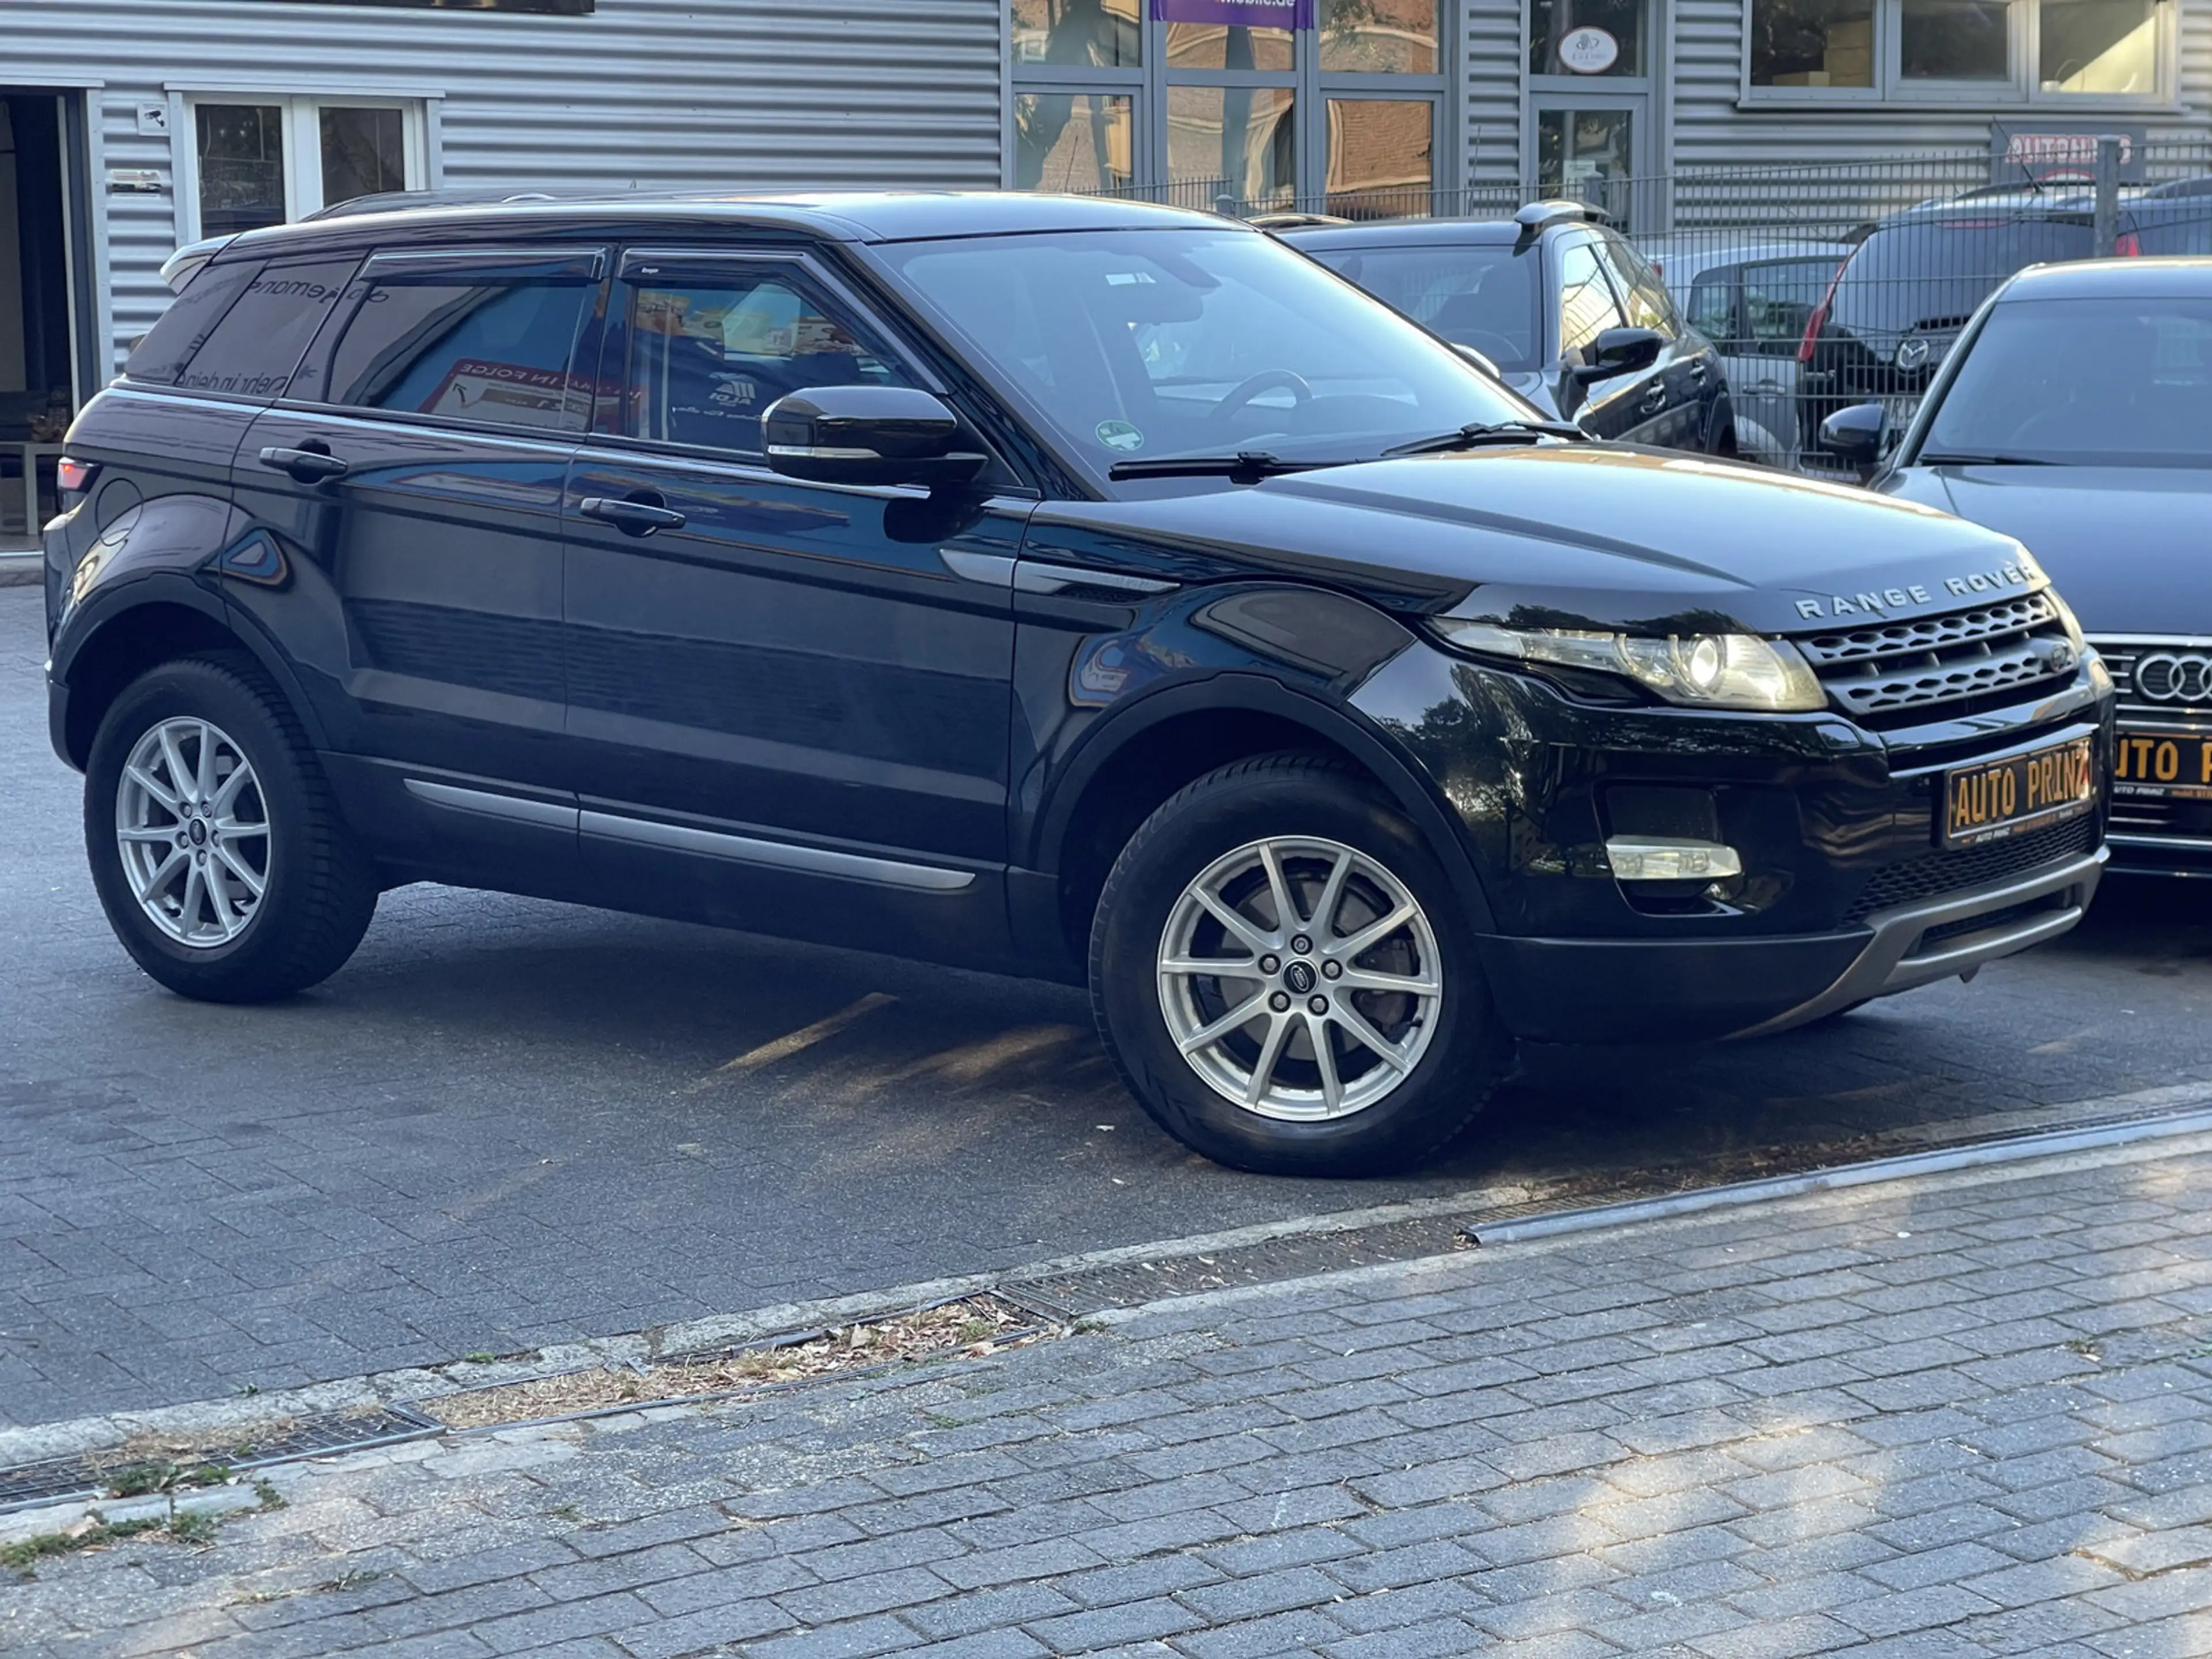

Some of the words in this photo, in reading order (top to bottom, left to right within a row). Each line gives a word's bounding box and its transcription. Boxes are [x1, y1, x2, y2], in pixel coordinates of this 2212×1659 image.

[1794, 584, 1932, 619] RANGE
[1944, 563, 2037, 596] ROVER
[2115, 738, 2179, 781] UTO
[1956, 767, 2015, 827] AUTO
[2027, 744, 2089, 810] PRINZ
[2113, 786, 2134, 794] UTO
